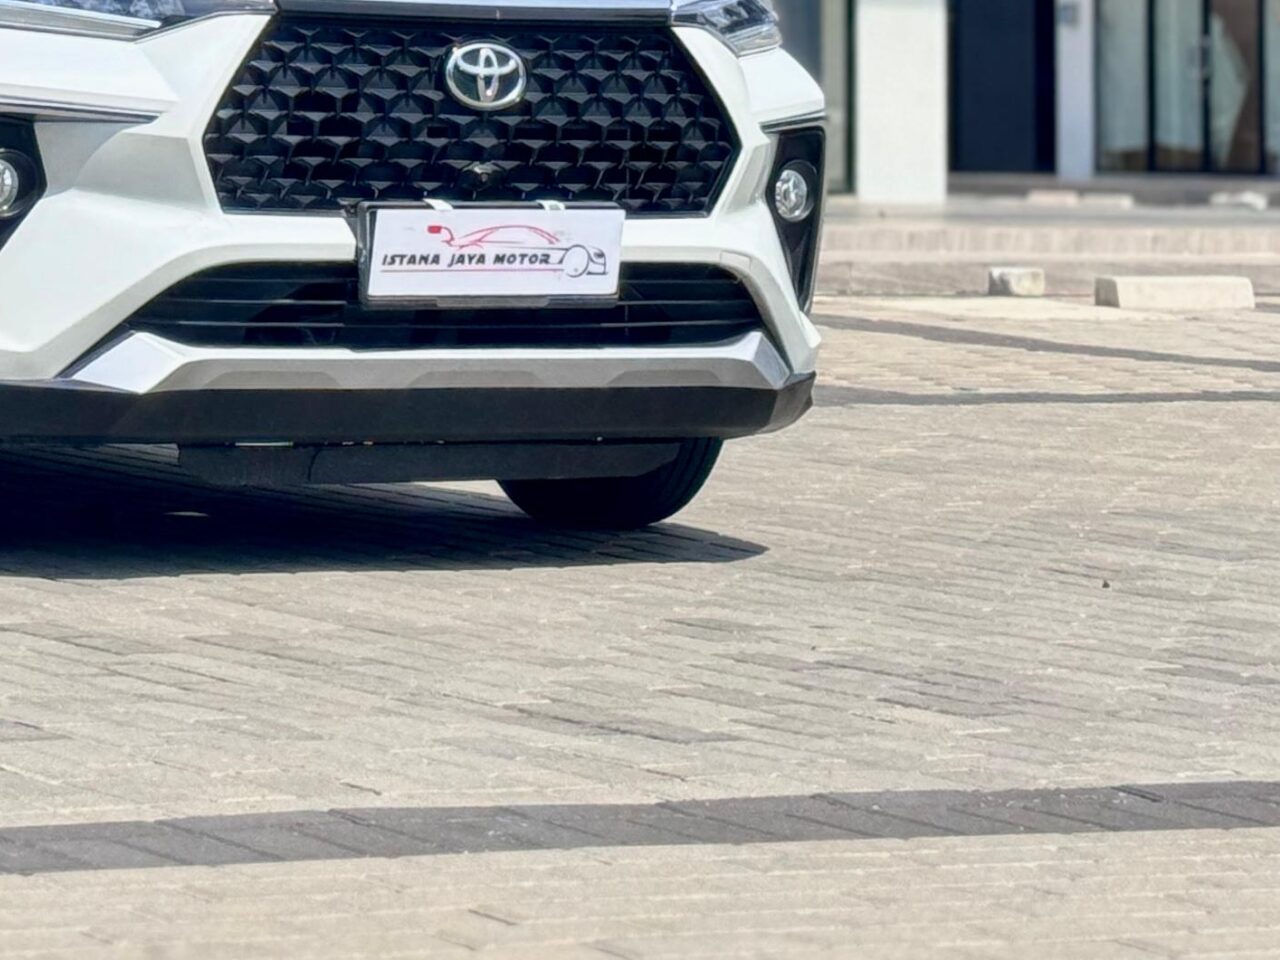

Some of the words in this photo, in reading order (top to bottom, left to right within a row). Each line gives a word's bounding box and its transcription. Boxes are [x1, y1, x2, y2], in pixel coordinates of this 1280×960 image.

[381, 253, 440, 266] ISTANA
[447, 253, 486, 268] JAYA
[492, 252, 551, 266] MOTOR
